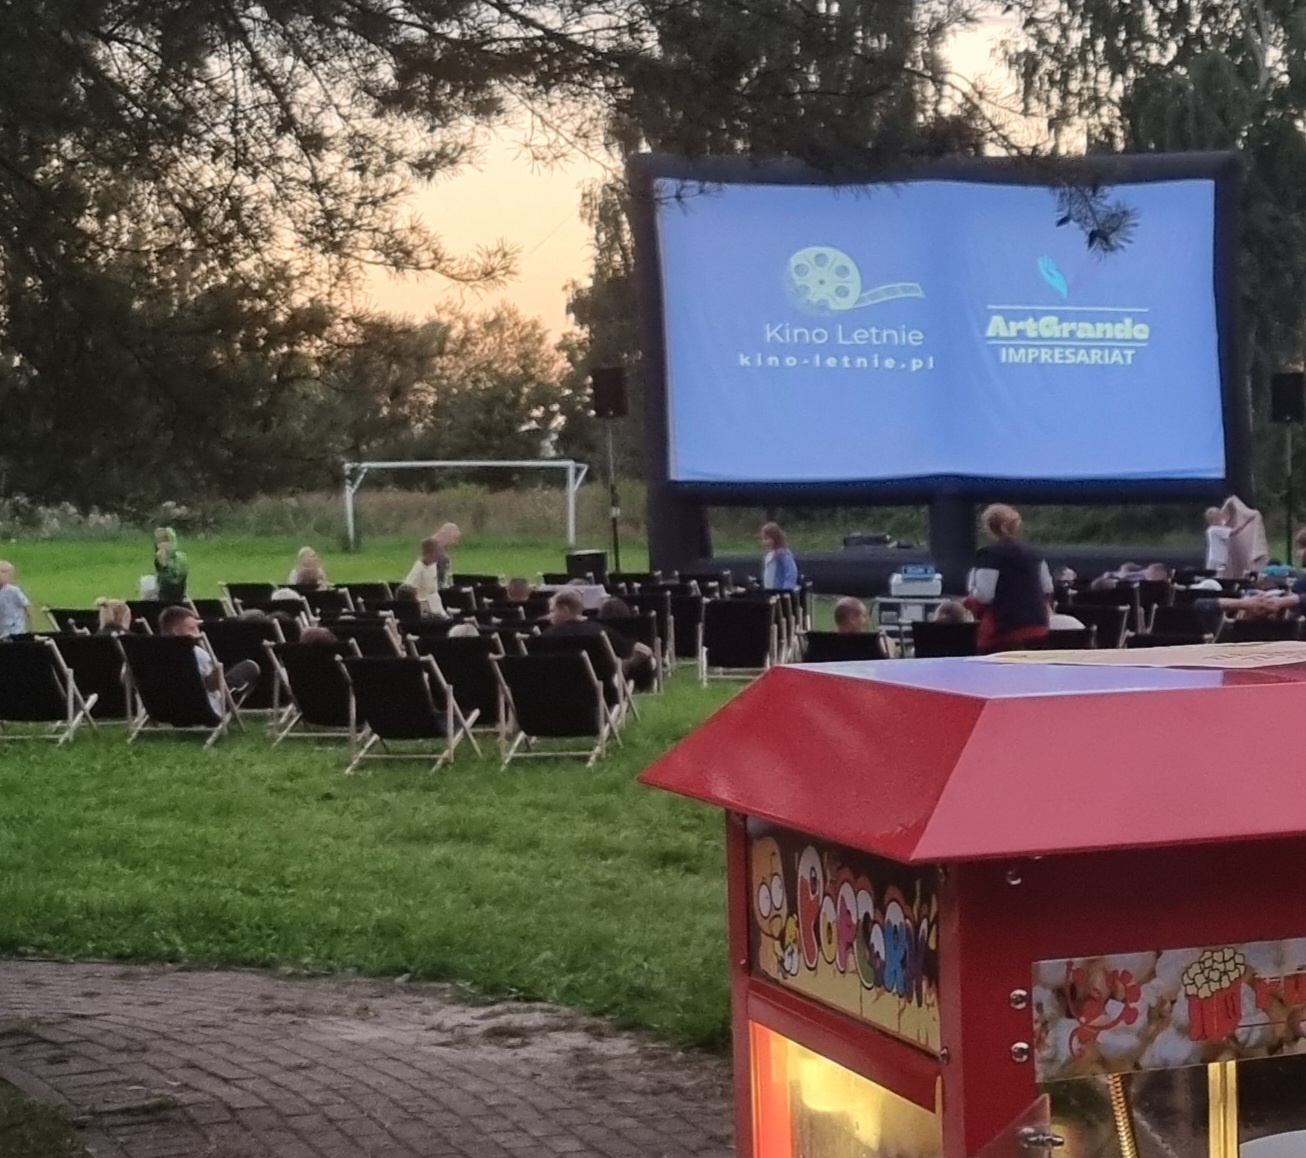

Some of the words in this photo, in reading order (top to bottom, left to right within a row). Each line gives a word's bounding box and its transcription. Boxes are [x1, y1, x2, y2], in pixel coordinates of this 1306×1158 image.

[765, 323, 829, 345] Kino
[837, 324, 925, 346] Letnie
[986, 315, 1150, 340] ArtGrande
[739, 353, 935, 372] kino-letnie.pl
[1001, 347, 1136, 365] IMPRESARIAT
